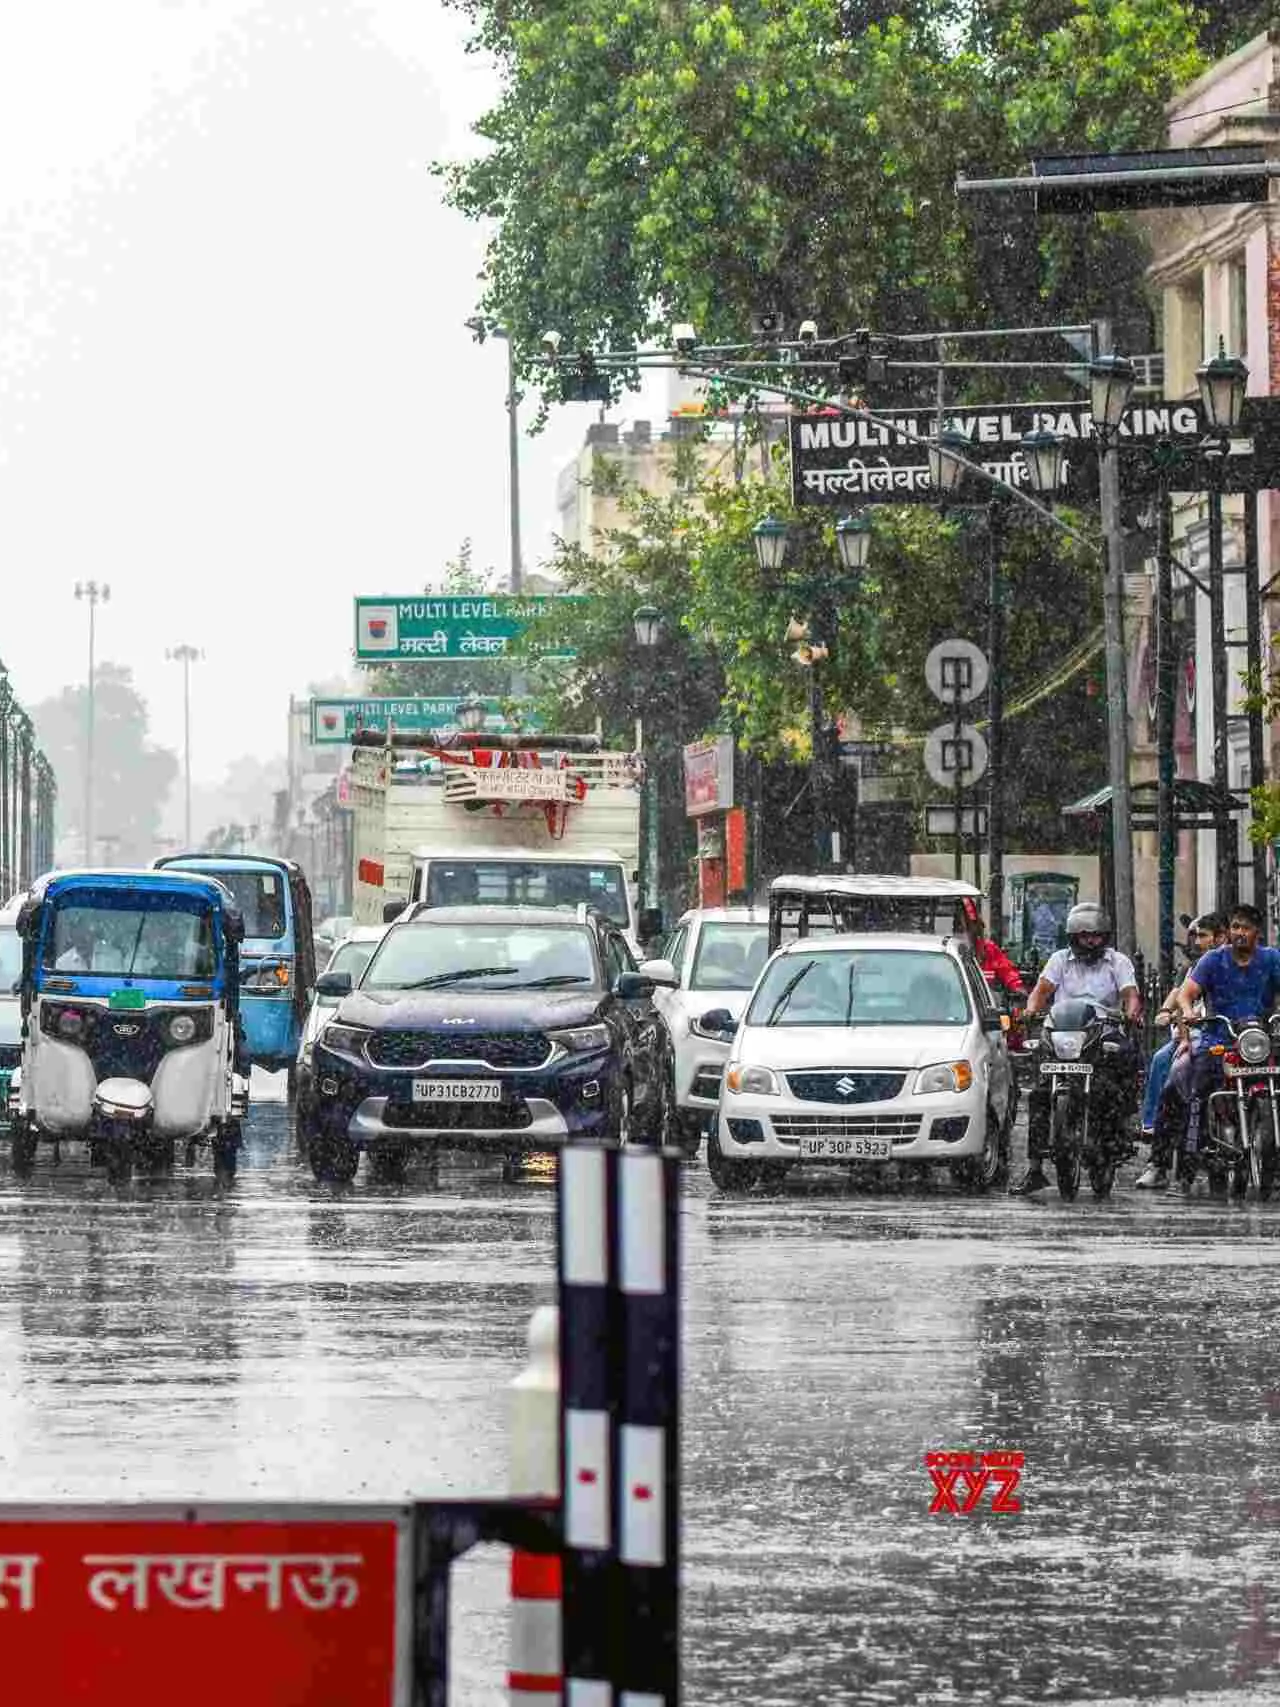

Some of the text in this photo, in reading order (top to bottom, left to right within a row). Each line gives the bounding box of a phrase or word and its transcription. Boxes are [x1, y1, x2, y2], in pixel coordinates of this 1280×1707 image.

[399, 604, 448, 619] MULTI
[453, 603, 501, 618] LEVEL
[399, 630, 448, 654] मल्टी
[459, 630, 510, 654] लेवल
[384, 702, 419, 714] LEVEL
[420, 1084, 500, 1098] UP31CB2770
[82, 1553, 364, 1612] लखनऊ
